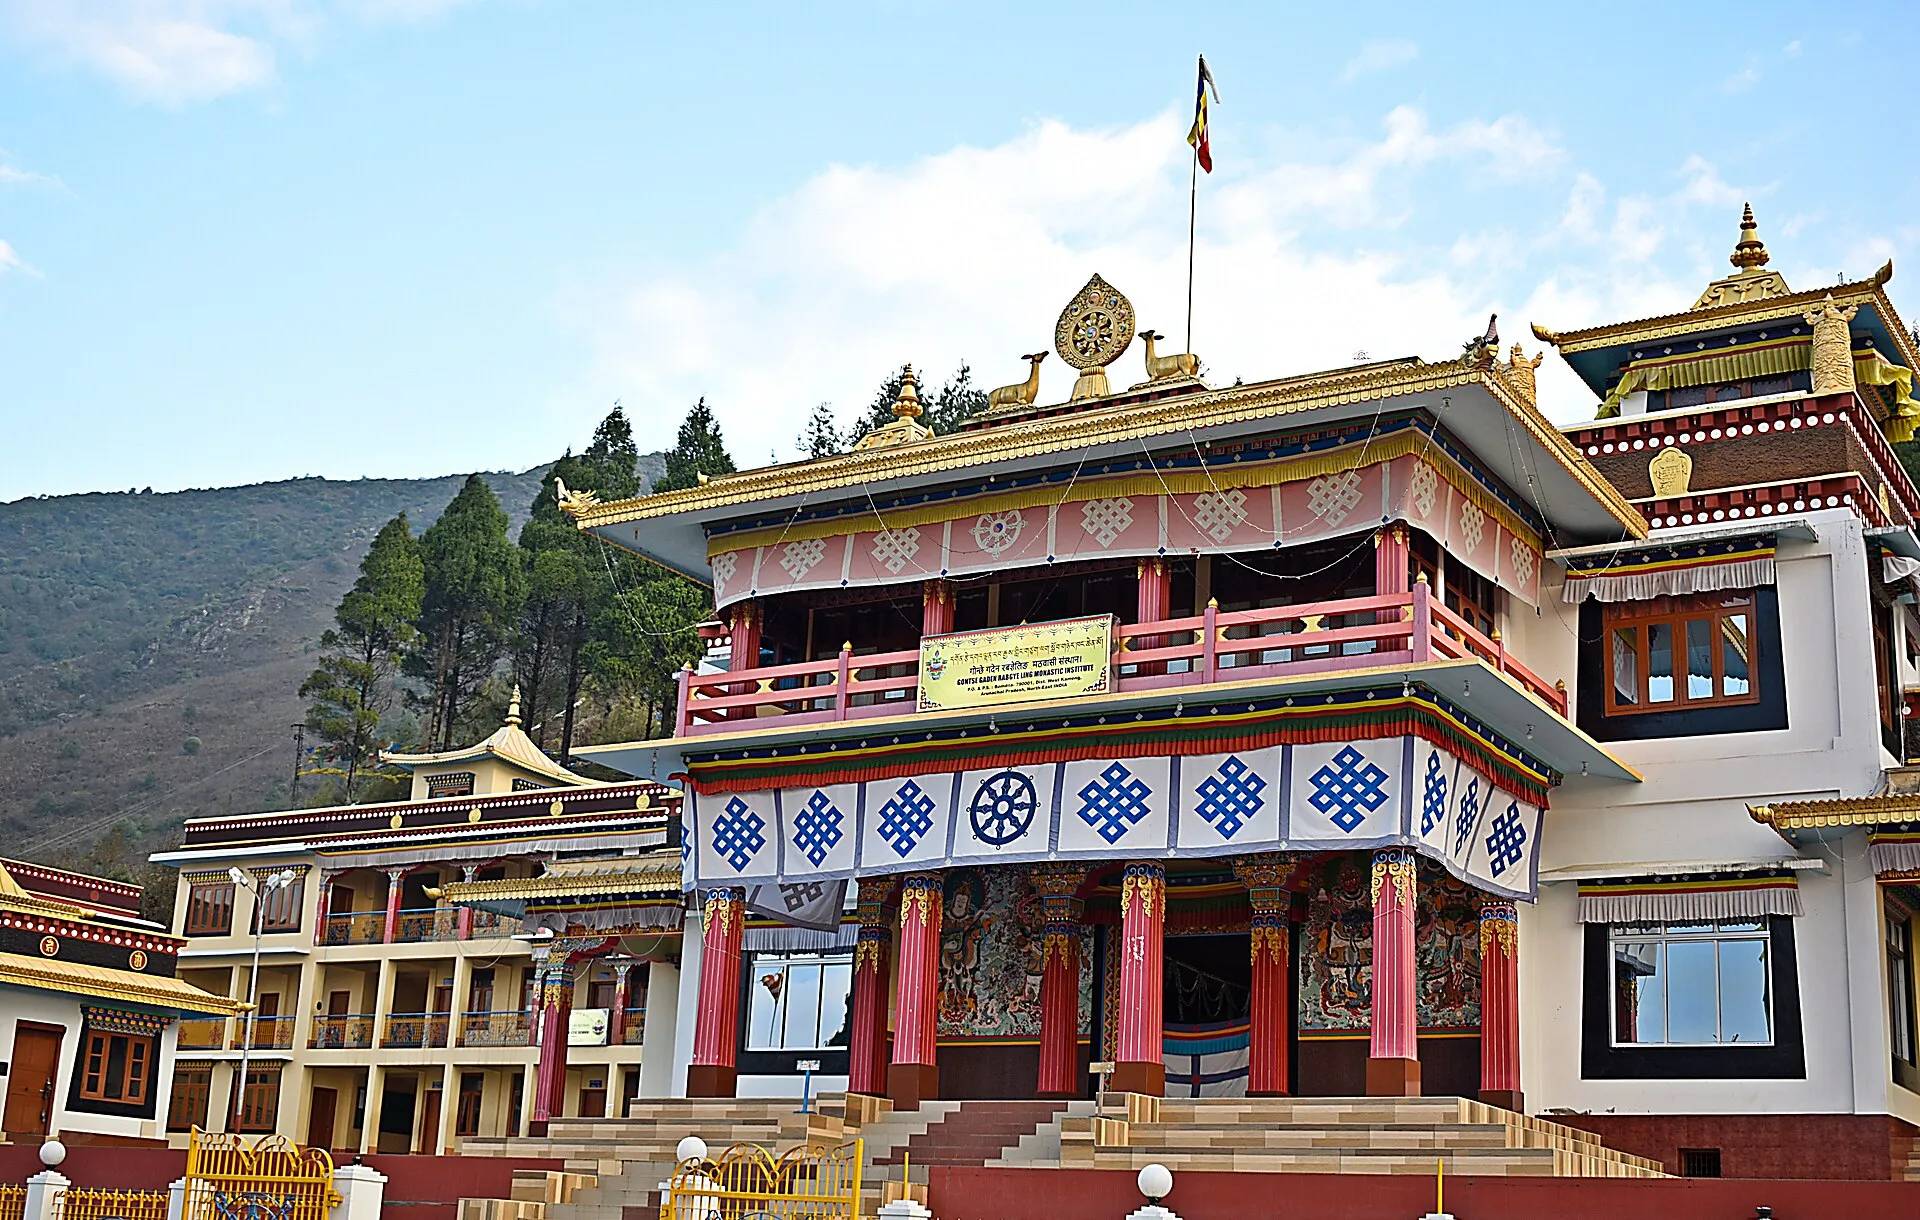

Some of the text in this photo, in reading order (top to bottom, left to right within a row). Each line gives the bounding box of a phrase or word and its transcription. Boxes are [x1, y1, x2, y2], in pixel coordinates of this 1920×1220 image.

[978, 675, 996, 683] GADEN
[998, 673, 1019, 681] RABGYE
[1034, 668, 1063, 677] MONASTIC
[1064, 665, 1093, 673] INSTITUTE
